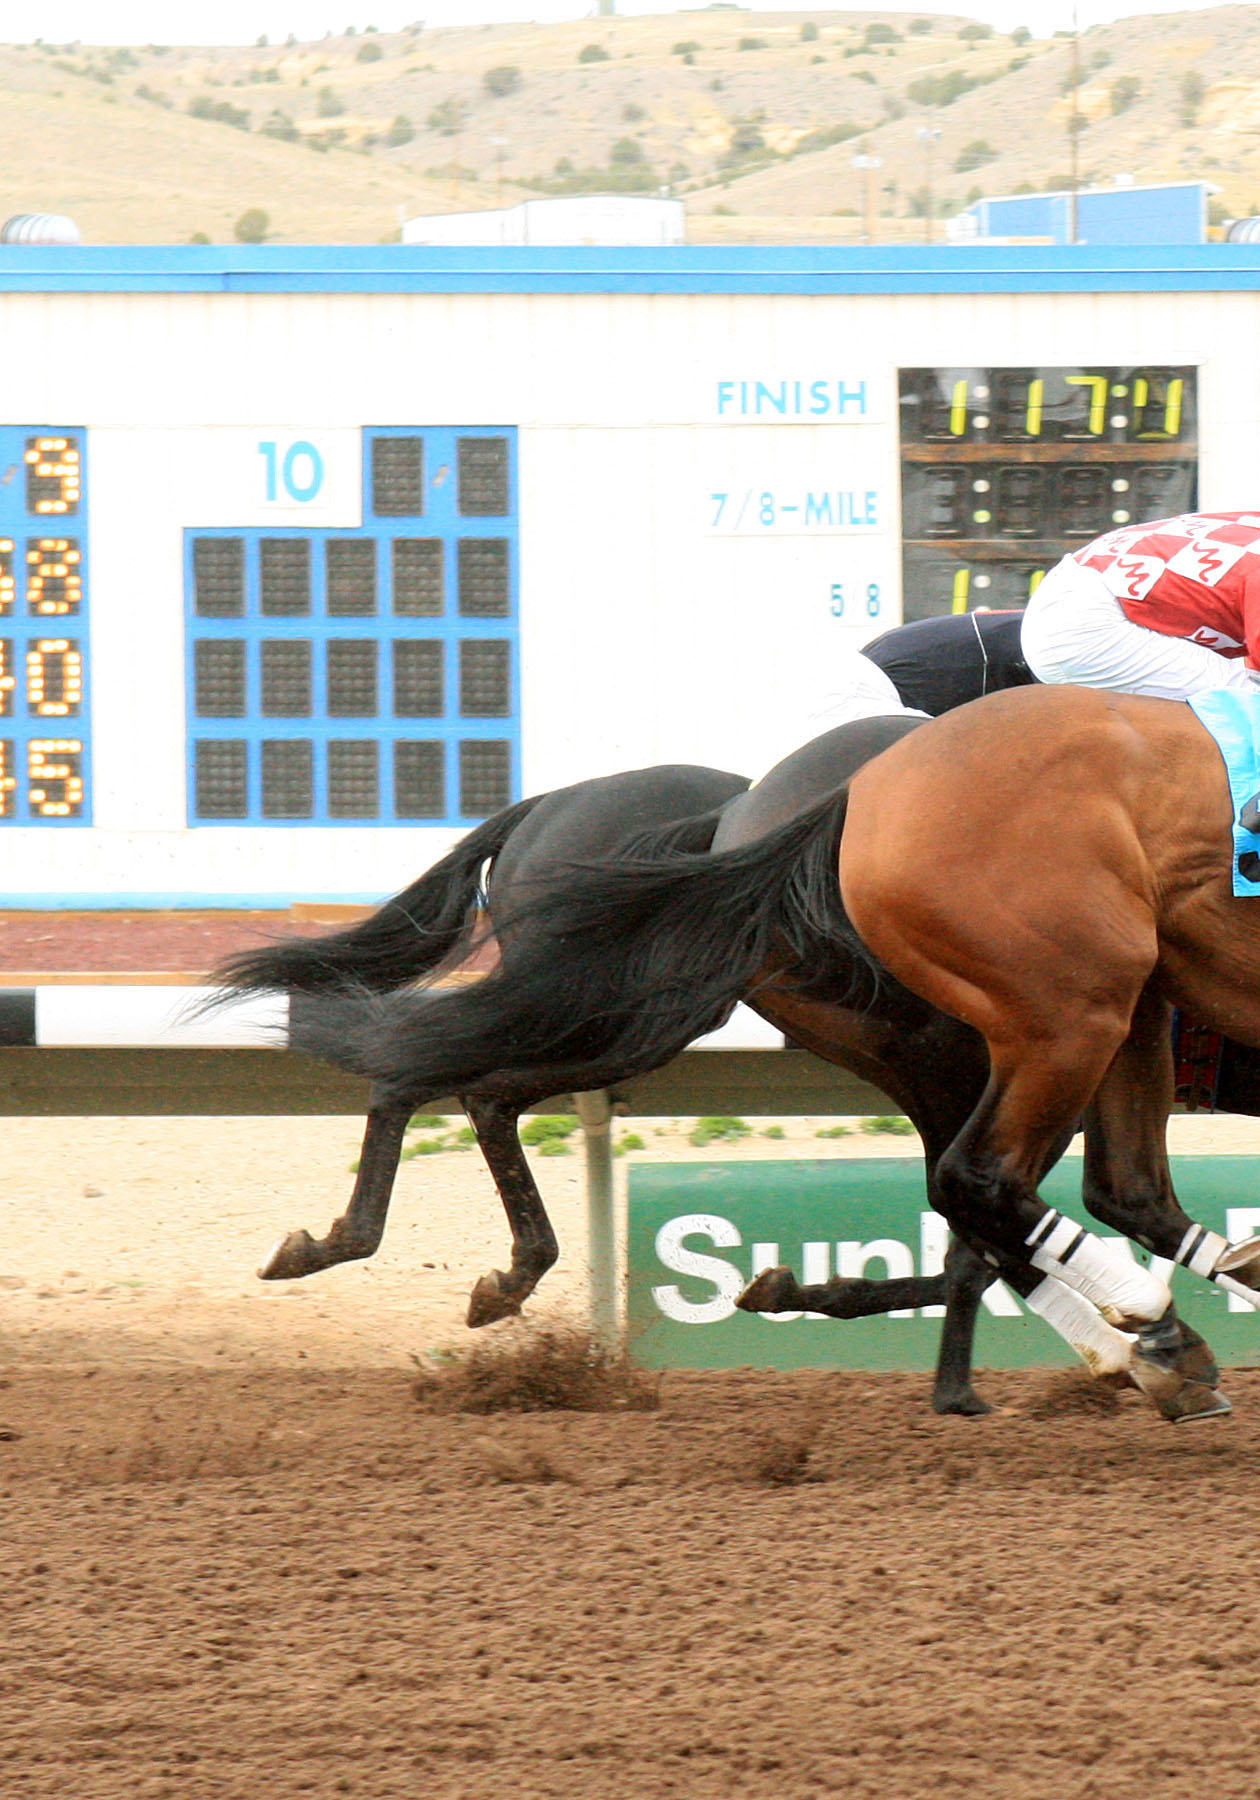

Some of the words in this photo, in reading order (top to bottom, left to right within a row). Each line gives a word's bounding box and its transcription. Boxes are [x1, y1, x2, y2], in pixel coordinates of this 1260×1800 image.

[716, 380, 867, 415] FINISH
[257, 440, 325, 502] 10
[709, 489, 879, 531] 7/8-MILE
